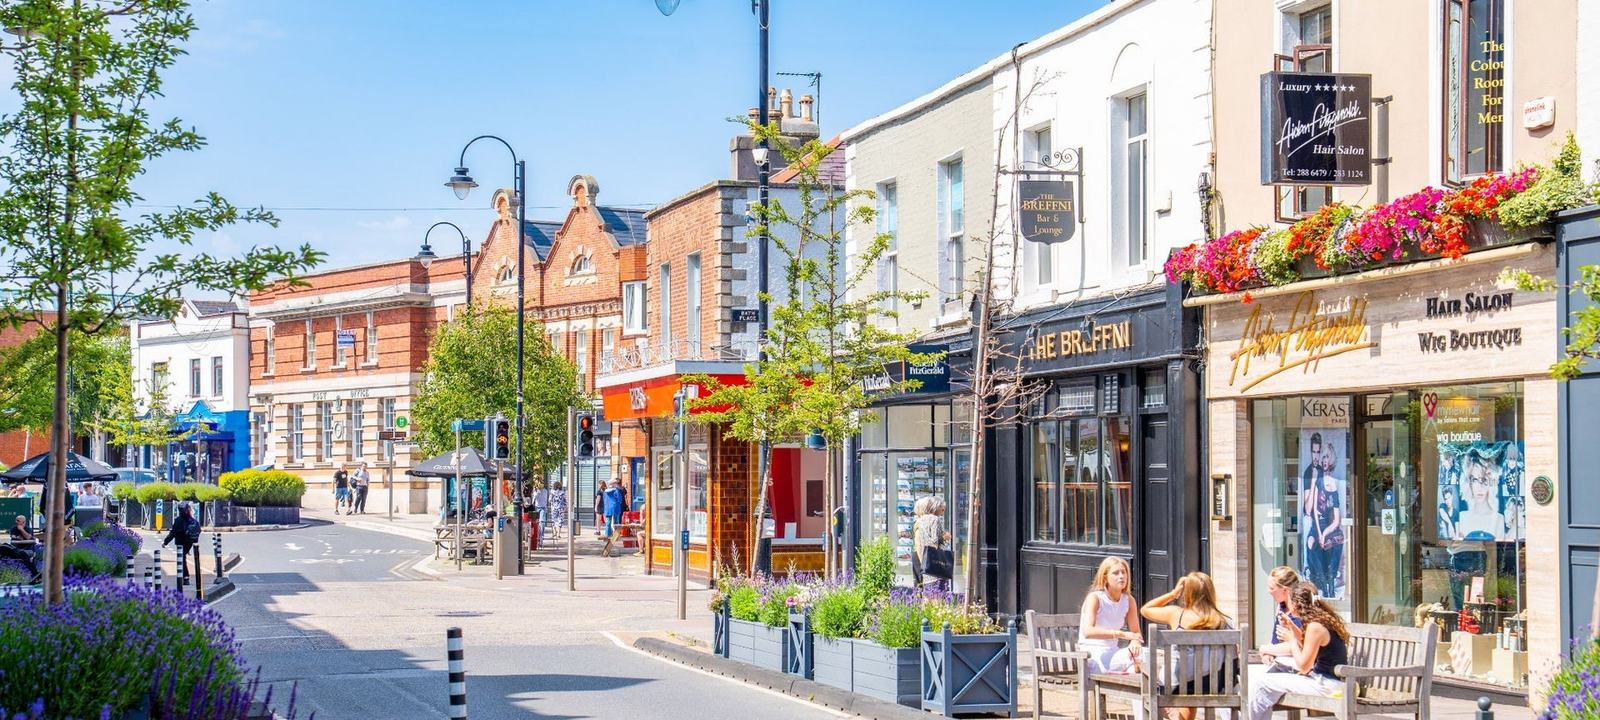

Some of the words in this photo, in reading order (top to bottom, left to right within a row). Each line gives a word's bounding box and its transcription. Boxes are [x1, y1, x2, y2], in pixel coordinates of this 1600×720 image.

[1280, 82, 1312, 93] Luxury
[1482, 94, 1505, 106] For
[1313, 145, 1335, 154] Hair
[1337, 146, 1365, 155] Salon
[1311, 169, 1327, 177] 6479
[1347, 170, 1363, 178] 1124
[1023, 200, 1072, 211] BREFFNI
[1037, 214, 1051, 223] Bar
[1053, 214, 1060, 223] &
[1034, 225, 1063, 237] Lounge
[1426, 297, 1462, 318] HAIR
[1465, 292, 1513, 313] SALON
[1417, 331, 1447, 355] WIG
[1449, 327, 1522, 352] BOUTIQUE
[909, 366, 945, 375] FitzGerald
[312, 392, 327, 400] POST
[350, 389, 370, 398] OFFICE
[1436, 431, 1449, 444] wig
[1450, 430, 1482, 443] boutique
